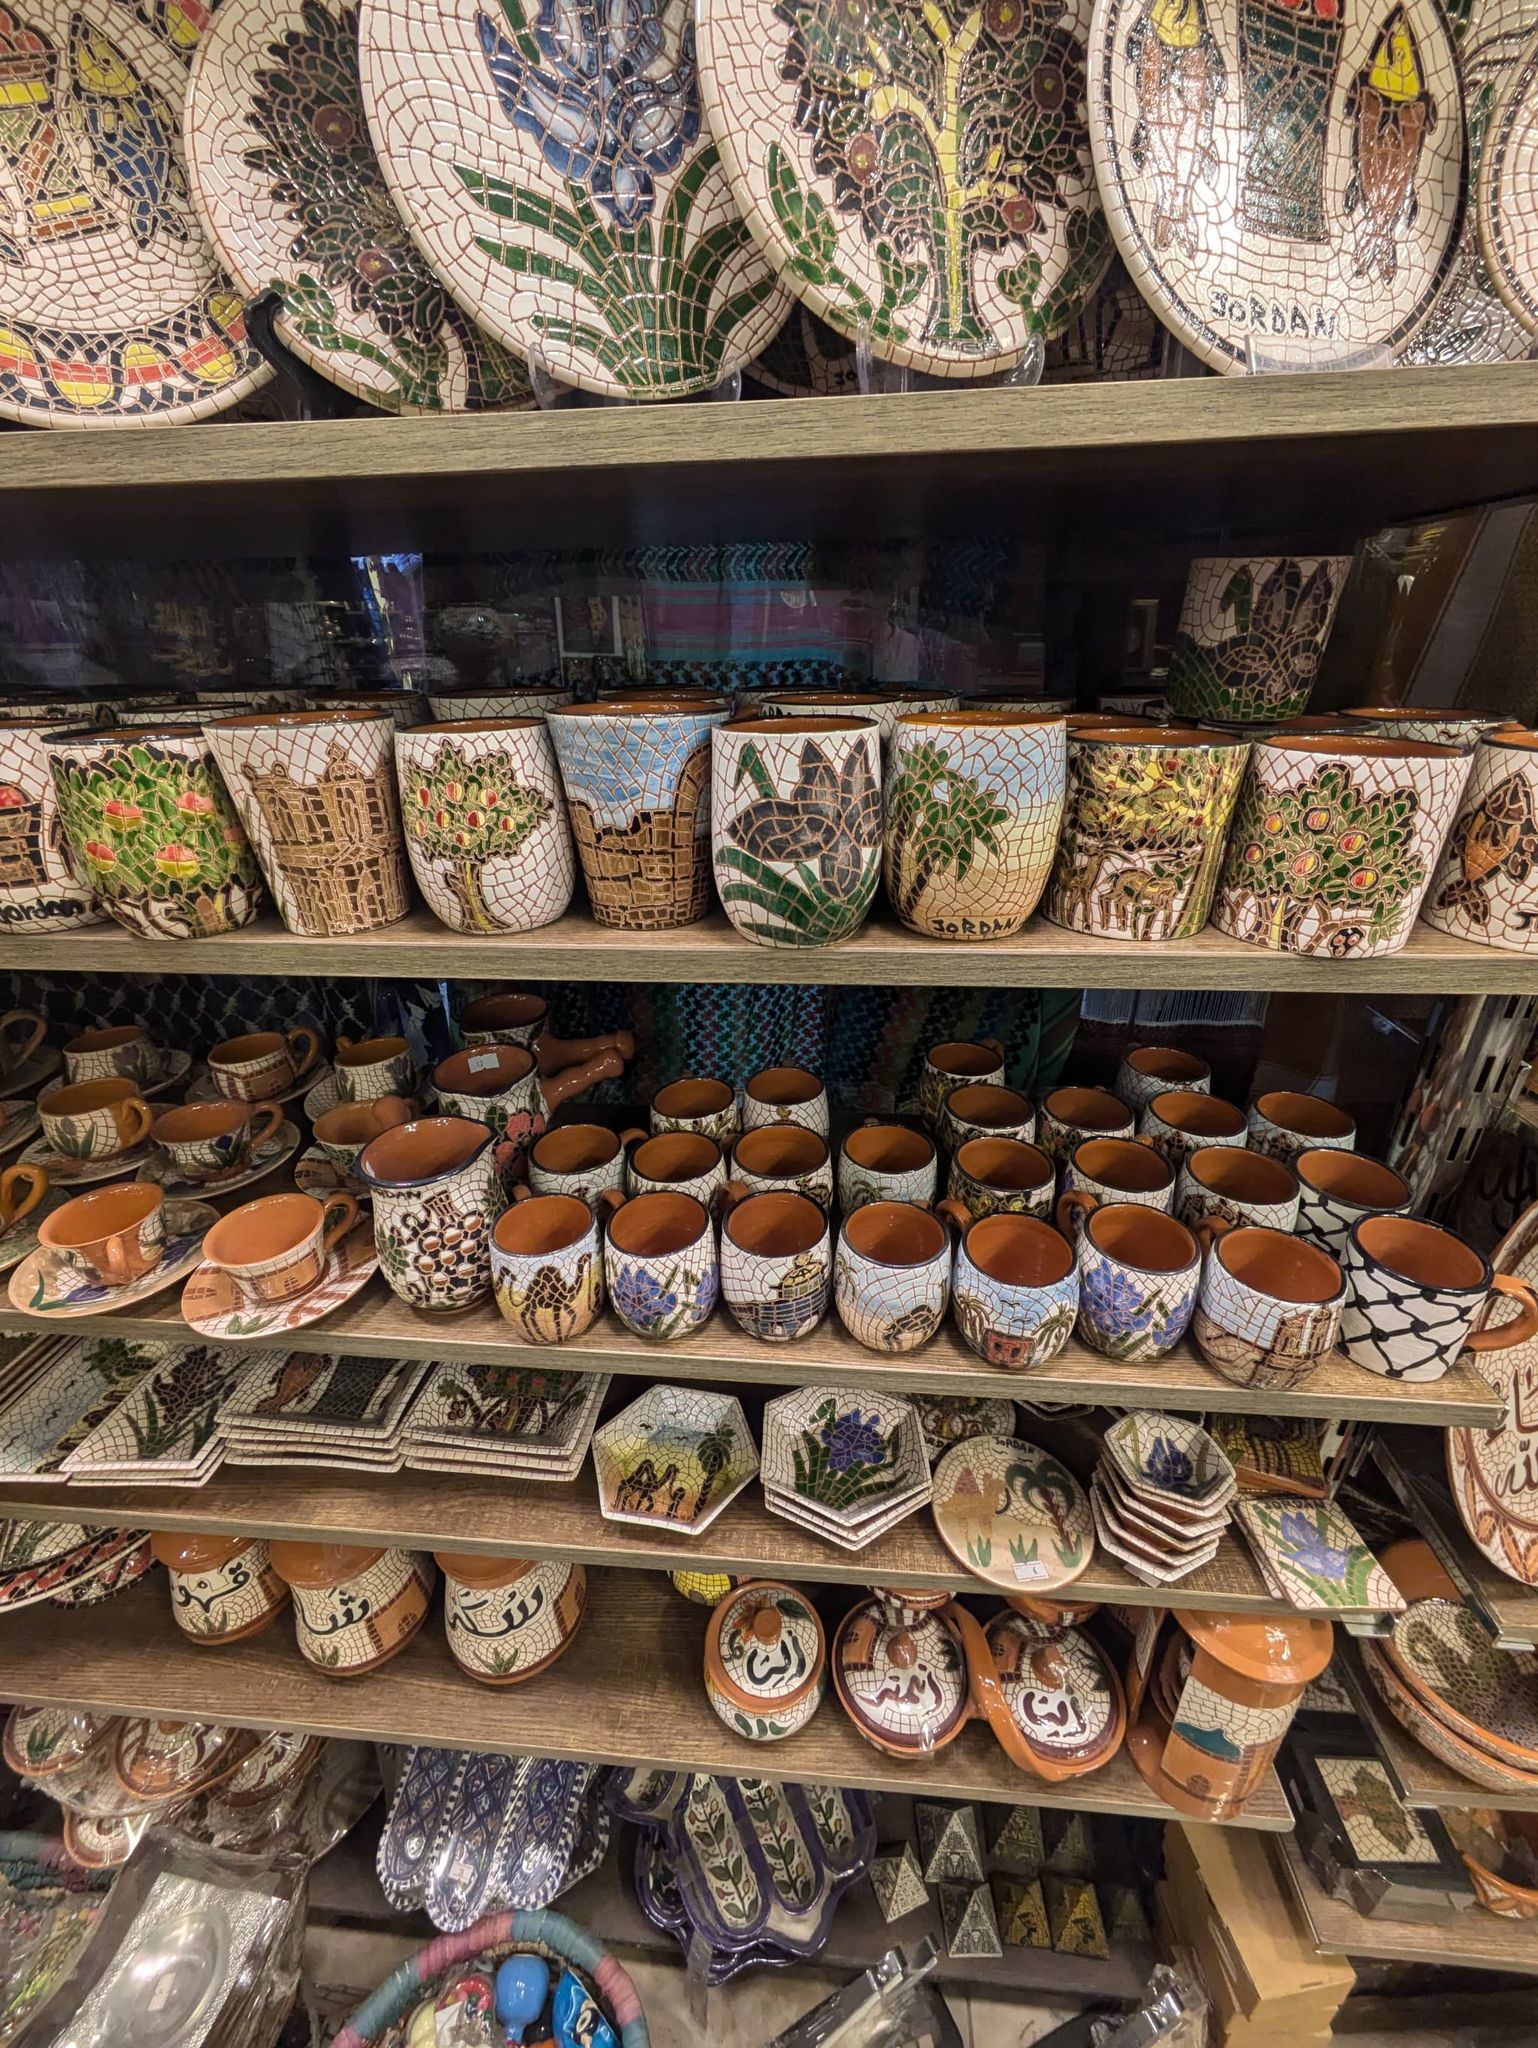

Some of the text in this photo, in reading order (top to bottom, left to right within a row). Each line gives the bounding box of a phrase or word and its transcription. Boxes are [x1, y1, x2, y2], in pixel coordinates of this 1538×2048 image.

[1207, 290, 1336, 338] JORDAN
[931, 916, 1018, 935] JORDAN
[992, 1436, 1035, 1454] JORDAN
